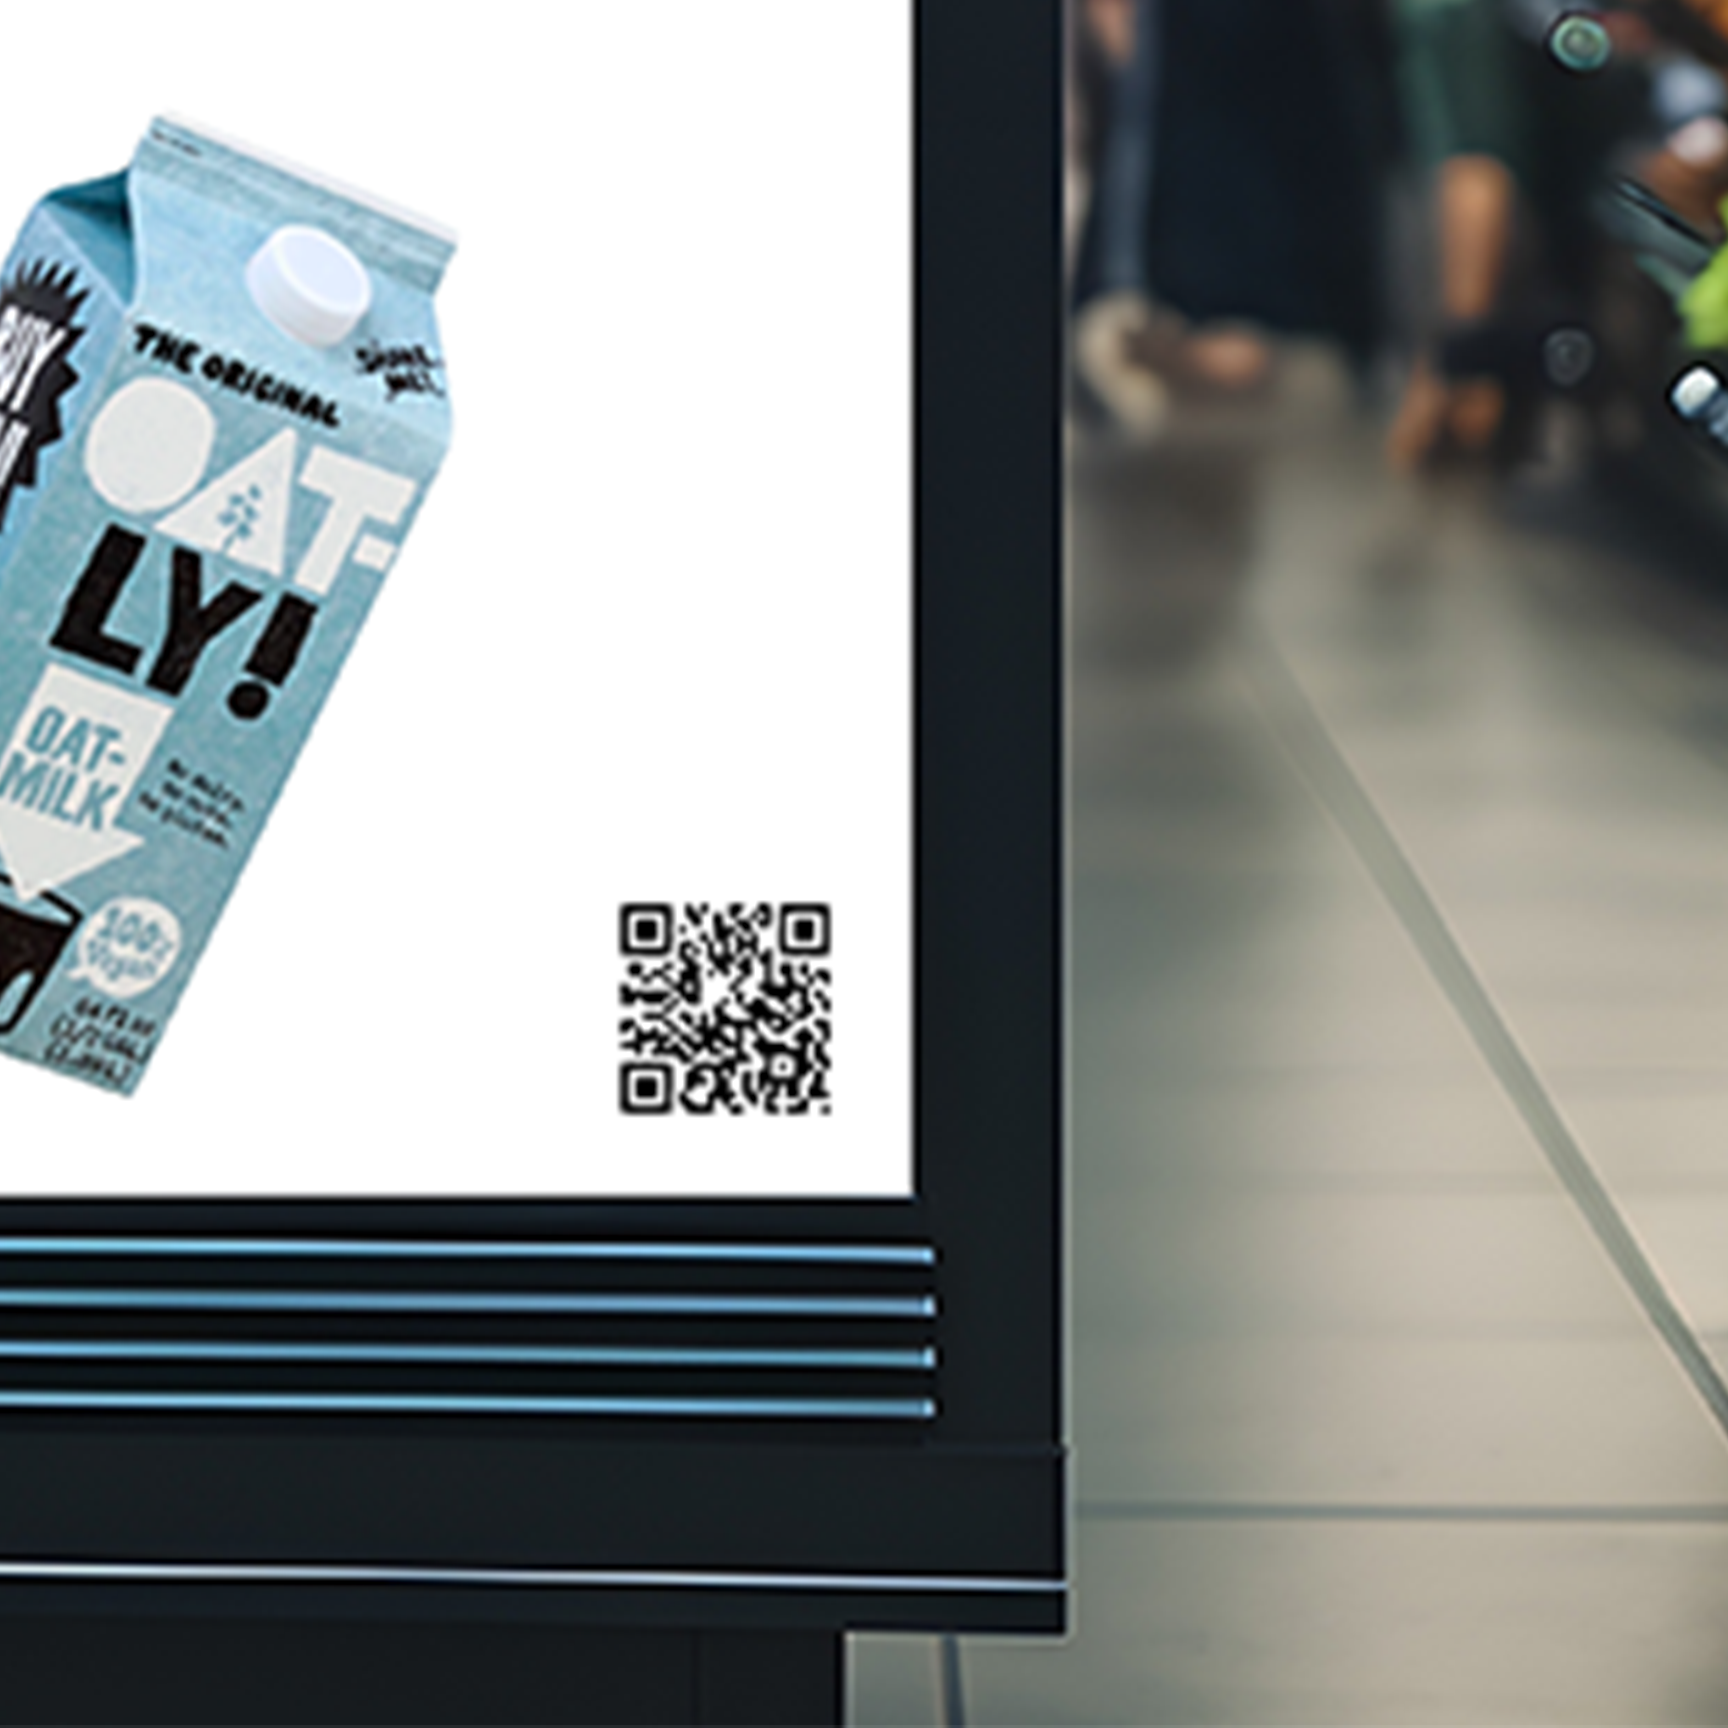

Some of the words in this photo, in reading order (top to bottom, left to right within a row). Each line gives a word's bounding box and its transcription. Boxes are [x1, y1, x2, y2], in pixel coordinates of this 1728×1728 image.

[133, 322, 202, 376] THE
[200, 352, 342, 429] ORIGINAL
[82, 375, 418, 597] OAT-
[48, 521, 321, 721] LY!
[24, 704, 127, 772] OAT-
